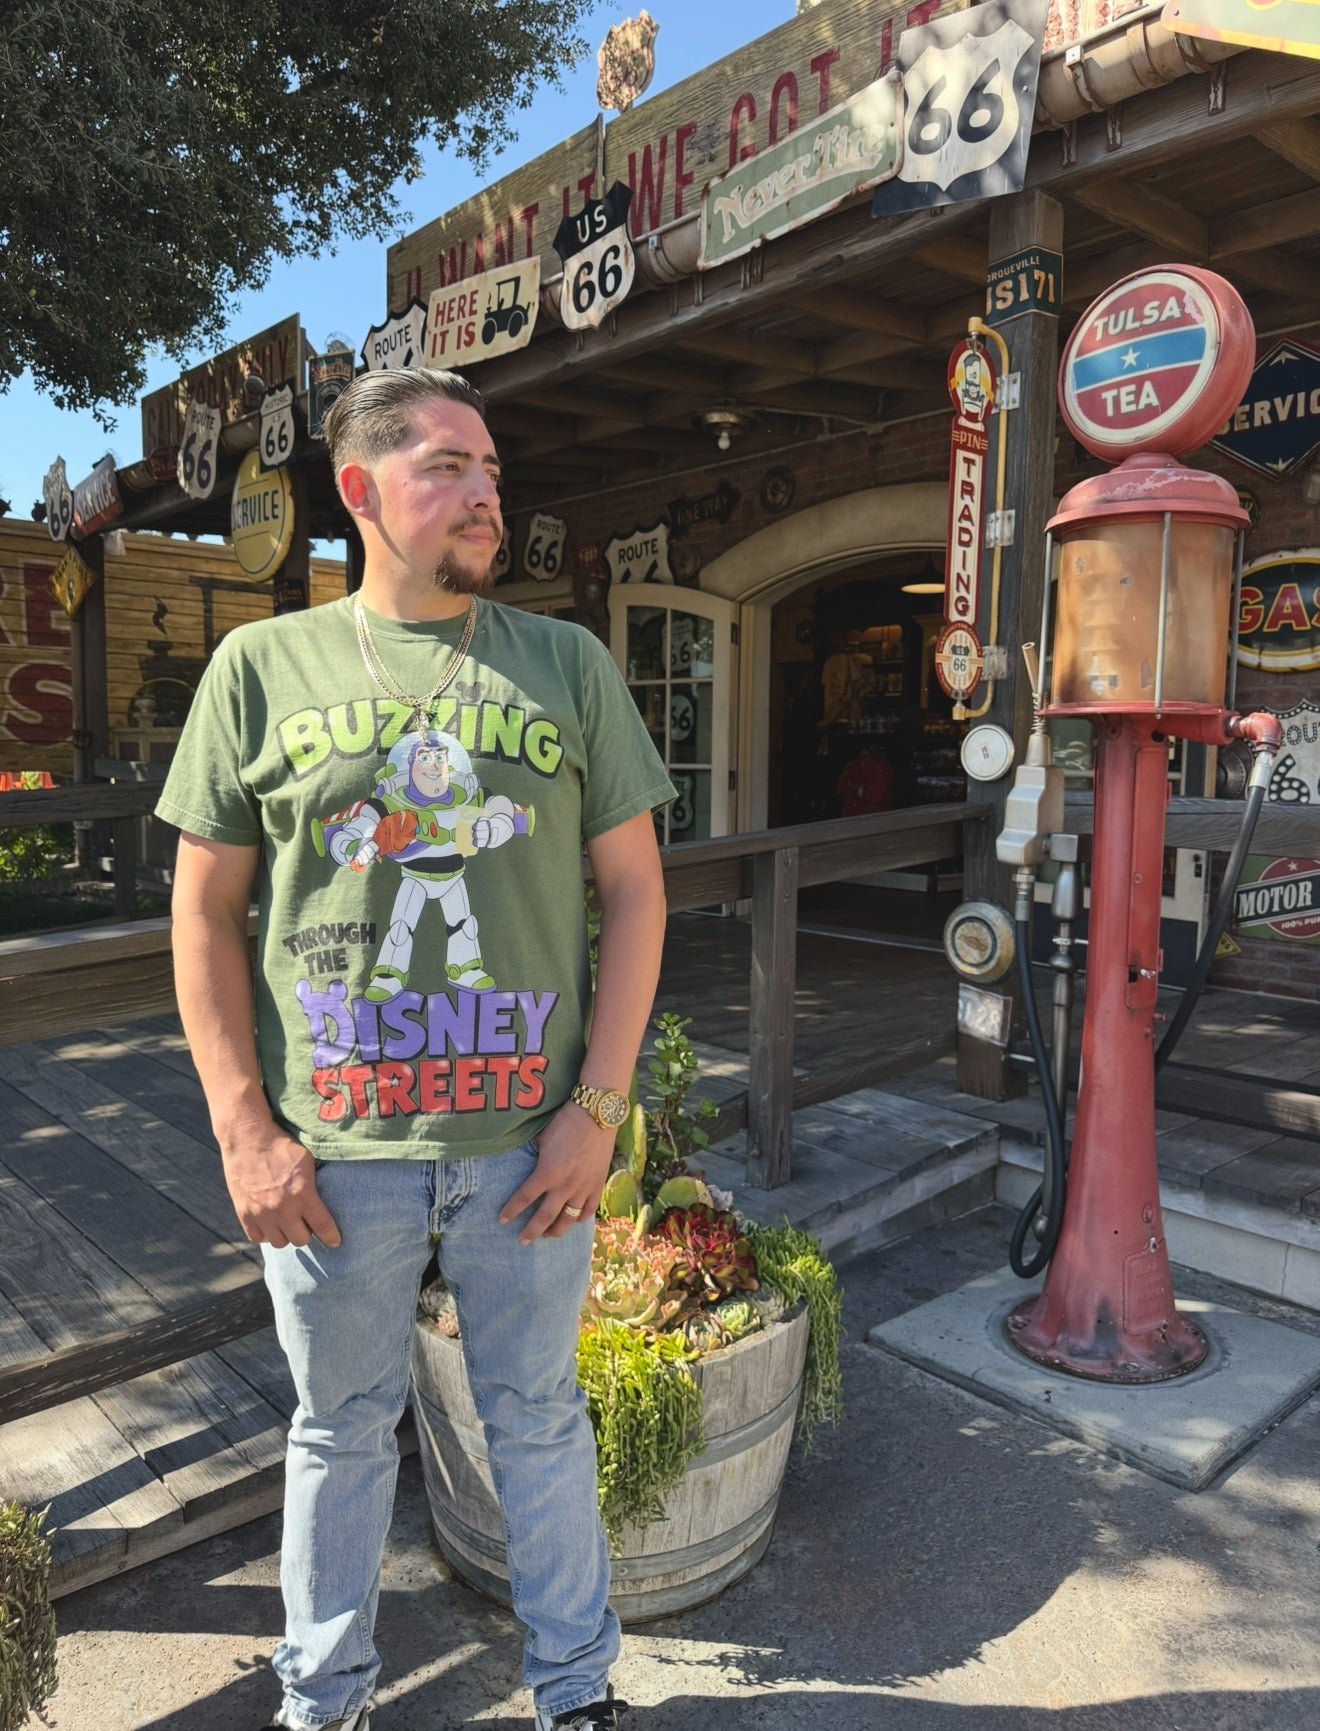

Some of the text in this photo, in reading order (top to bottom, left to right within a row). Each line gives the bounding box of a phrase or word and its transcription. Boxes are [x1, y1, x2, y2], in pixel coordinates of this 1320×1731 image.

[908, 58, 1004, 155] 66
[628, 121, 698, 241] WE
[729, 47, 841, 171] GOT
[713, 154, 811, 243] Never
[576, 204, 607, 243] US
[572, 244, 622, 314] 66
[434, 289, 480, 328] HERE
[1093, 295, 1182, 342] TULSA
[374, 324, 412, 361] ROUTE
[431, 332, 449, 358] IT
[456, 322, 476, 351] IS
[1102, 380, 1161, 418] TEA
[191, 409, 216, 431] ROUTE
[265, 420, 289, 458] 66
[960, 430, 981, 450] PIN
[183, 432, 213, 489] 66
[536, 519, 561, 535] ROUTE
[954, 455, 977, 617] TRADING
[528, 535, 559, 574] 66
[618, 537, 659, 565] ROUTE
[1229, 582, 1320, 635] GA
[953, 657, 967, 672] 66
[276, 697, 565, 783] BUZZING
[1237, 880, 1313, 920] MOTOR
[282, 922, 377, 958] THROUGH
[1281, 919, 1304, 931] 100%
[303, 948, 349, 977] THE
[295, 978, 560, 1070] DISNEY
[311, 1055, 549, 1123] STREETS
